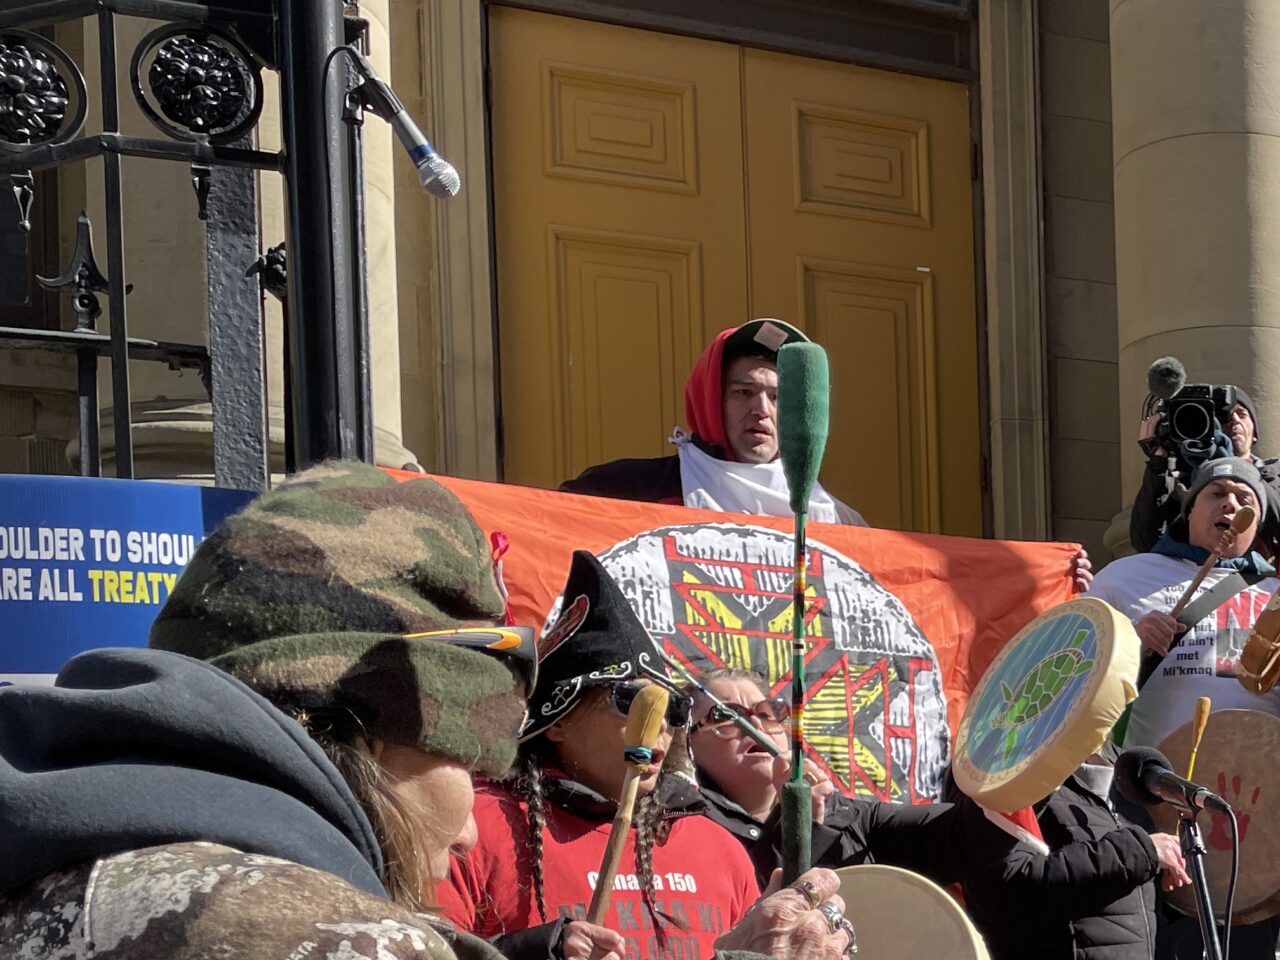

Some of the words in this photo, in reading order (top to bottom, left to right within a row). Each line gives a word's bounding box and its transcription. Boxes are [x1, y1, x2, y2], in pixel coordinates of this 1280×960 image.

[90, 529, 122, 562] TO
[0, 568, 33, 601] RE
[38, 568, 84, 602] ALL
[88, 569, 178, 605] TREATY
[1188, 636, 1214, 646] ain't
[1176, 651, 1199, 661] met
[587, 871, 664, 891] Cnaa
[665, 873, 697, 893] 150
